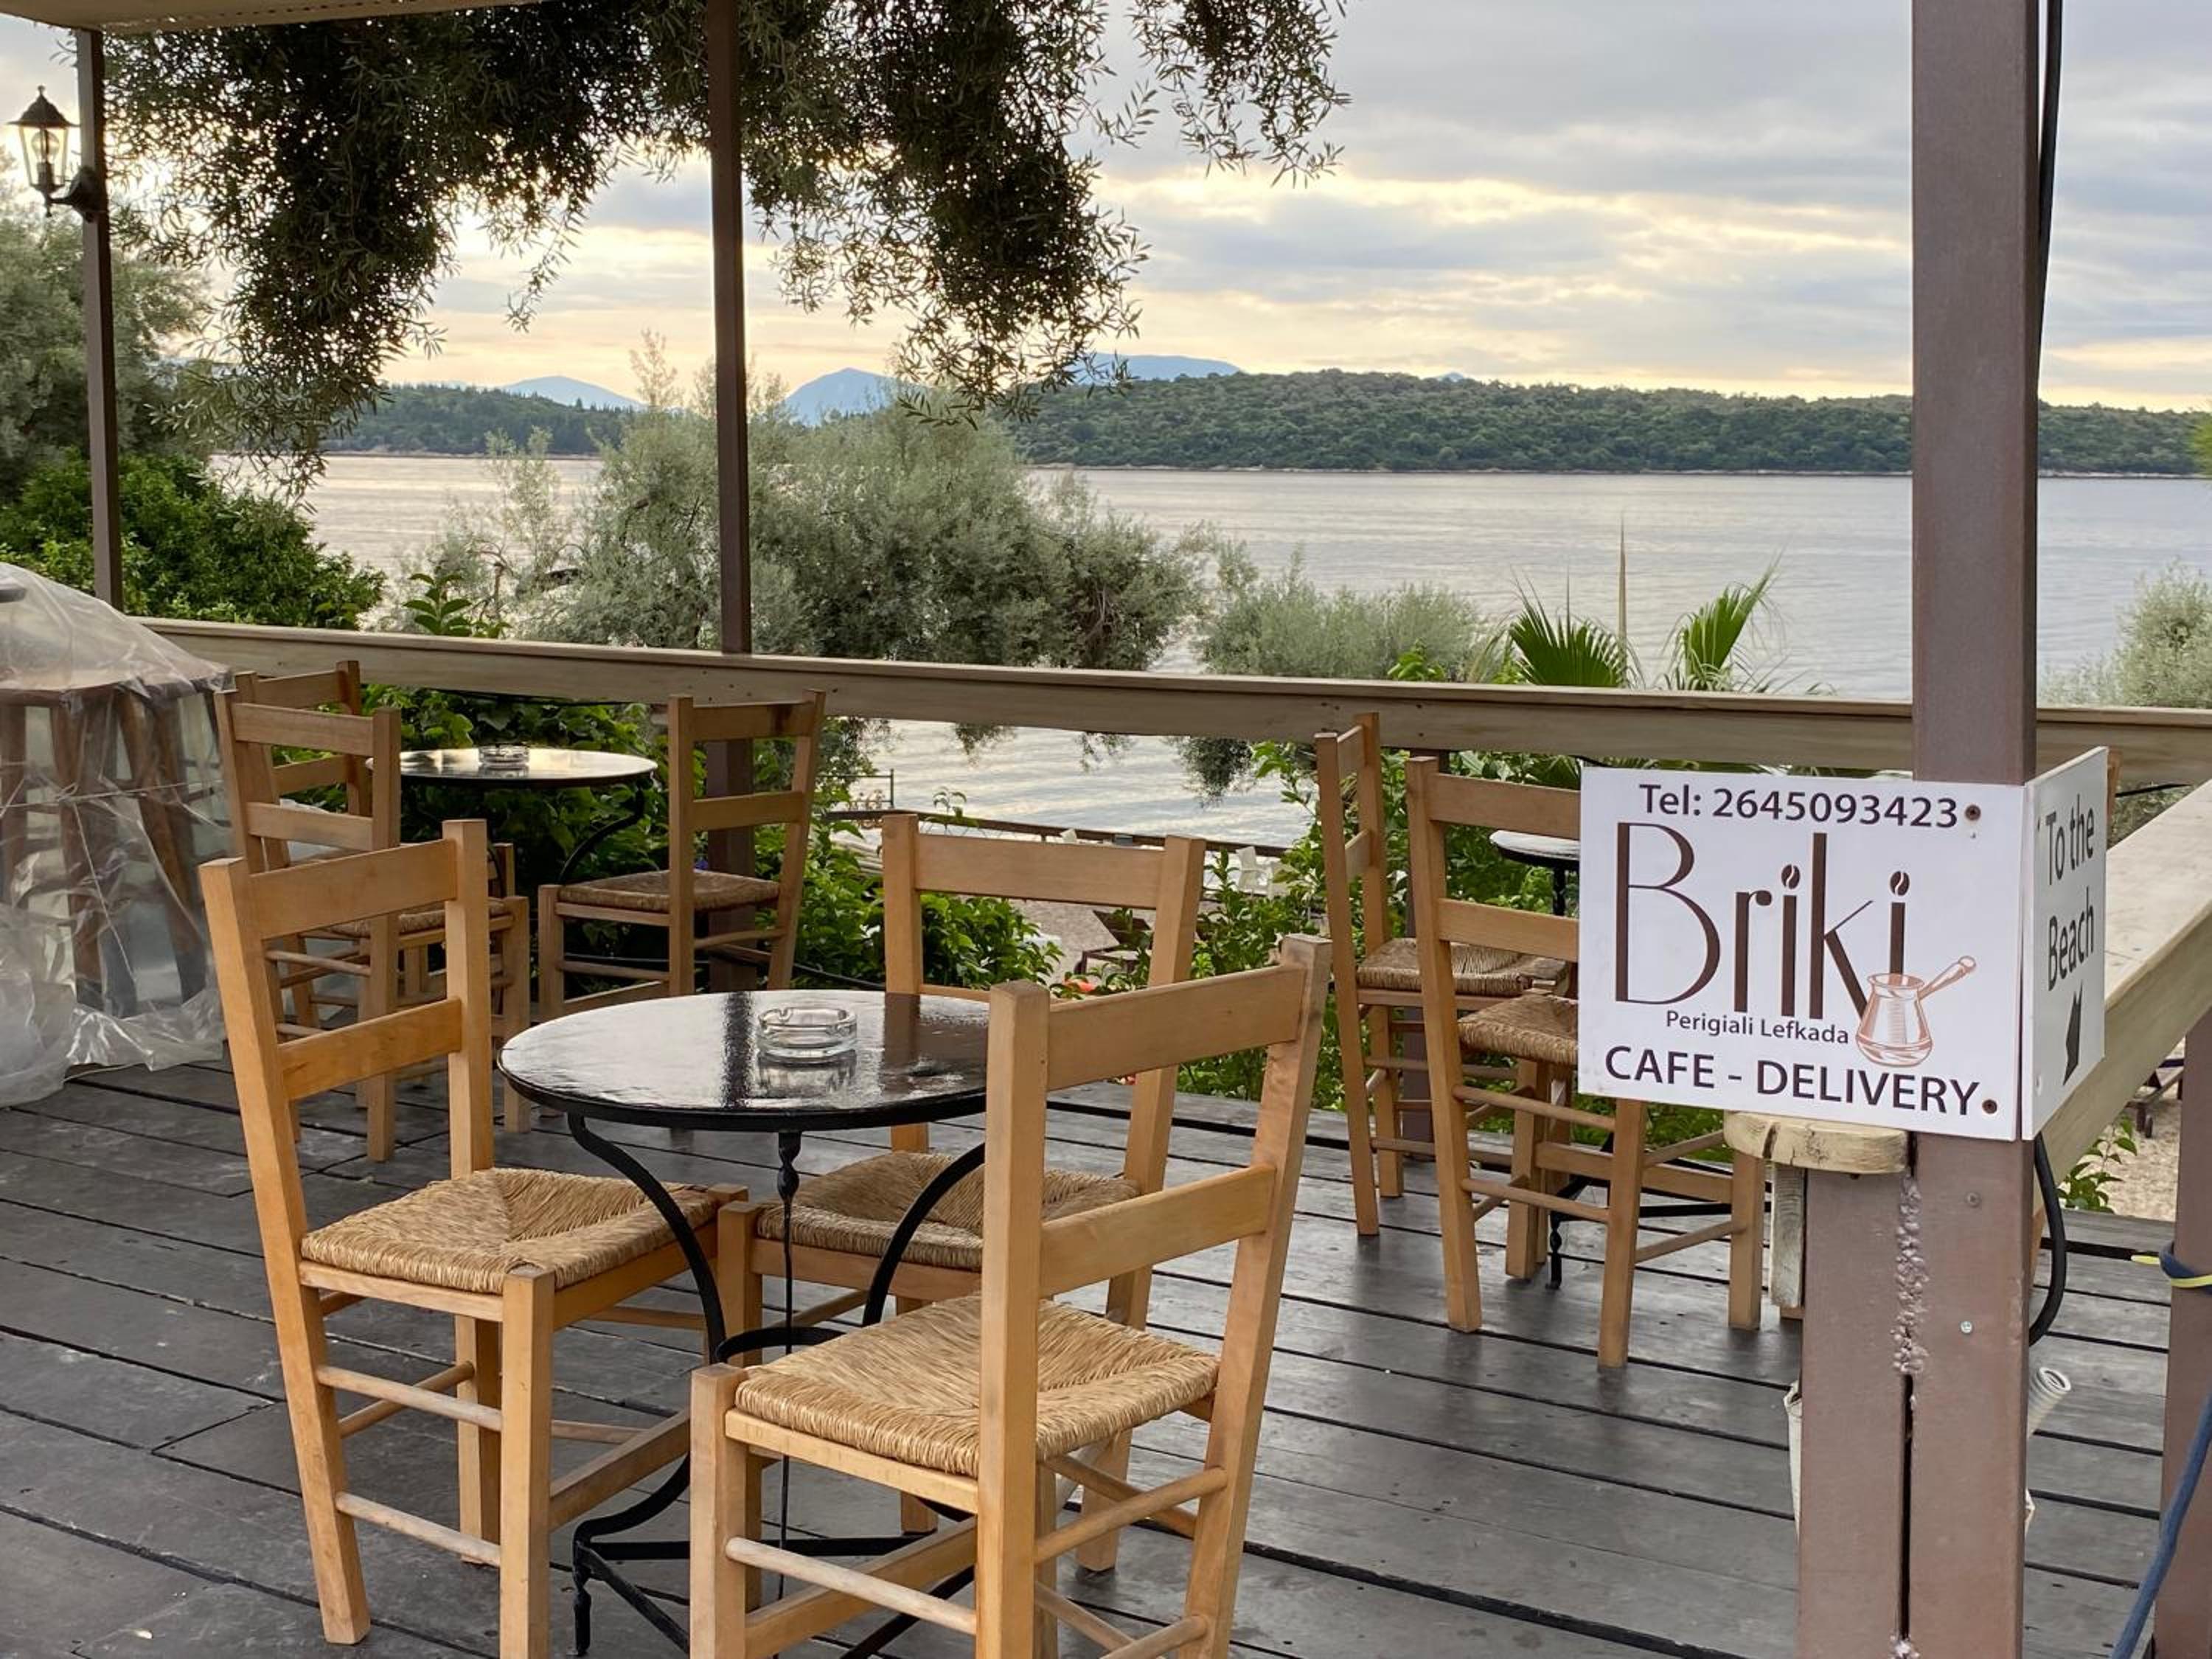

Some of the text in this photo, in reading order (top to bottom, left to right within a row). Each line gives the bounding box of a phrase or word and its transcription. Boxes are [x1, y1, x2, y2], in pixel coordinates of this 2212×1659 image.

[1638, 783, 1958, 829] Tel: 2645093423
[2045, 793, 2095, 886] To the
[1615, 821, 1910, 1020] Briki
[2048, 886, 2095, 992] Beach
[1666, 1010, 1850, 1045] Perigiali Lefkada
[1604, 1045, 1716, 1089] CAFE
[1756, 1060, 1980, 1116] DELIVERY
